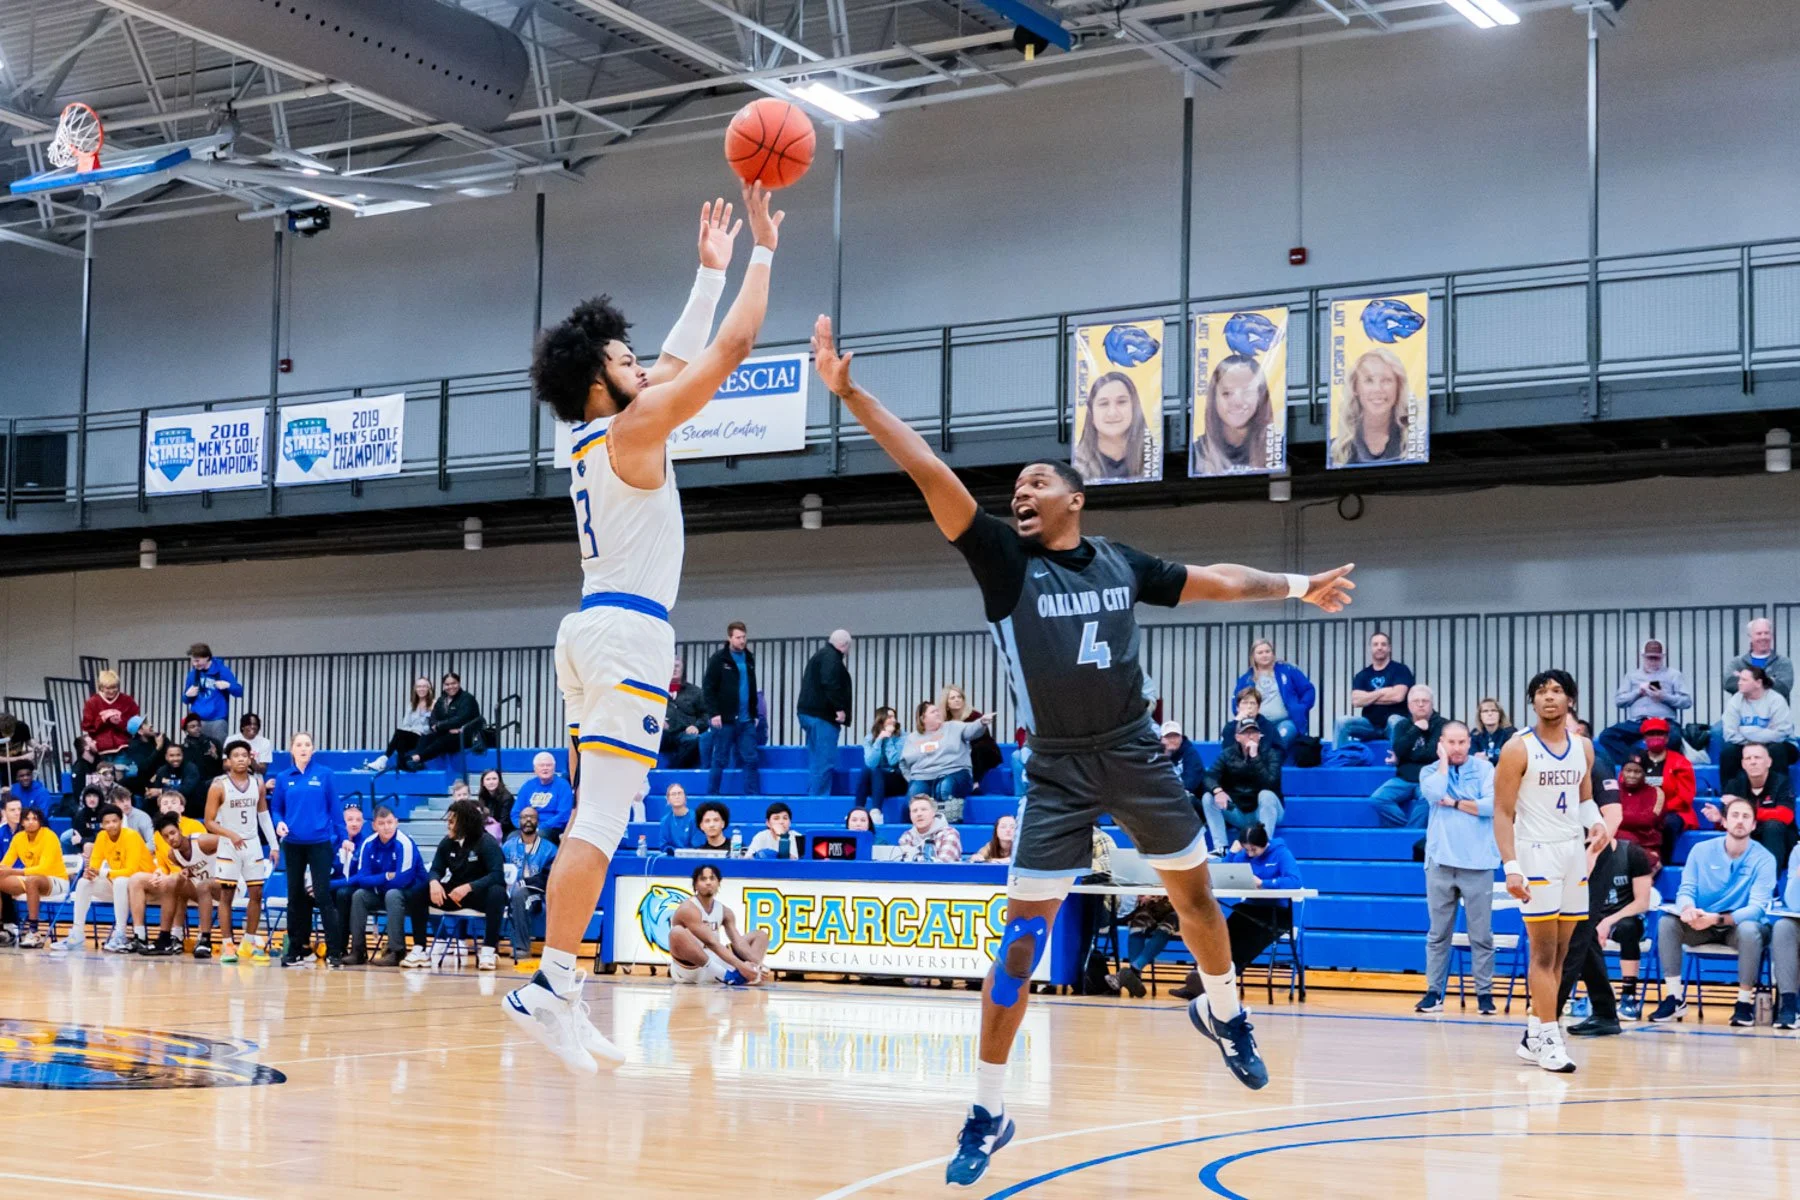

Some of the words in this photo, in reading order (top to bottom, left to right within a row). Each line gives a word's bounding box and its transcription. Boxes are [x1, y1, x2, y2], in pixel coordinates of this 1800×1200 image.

[718, 366, 796, 393] ESCIA!
[353, 409, 379, 429] 2019
[210, 422, 249, 440] 2018
[334, 430, 366, 446] MEN'S
[370, 427, 398, 443] GOLF
[681, 422, 723, 441] Second
[723, 420, 767, 440] Century
[149, 442, 194, 462] STATES
[198, 440, 231, 457] MEN'S
[235, 436, 259, 454] GOLF
[285, 433, 330, 454] STATES
[1143, 427, 1152, 478] HANNAH
[198, 454, 258, 476] CHAMPIONS
[333, 441, 398, 470] CHAMPIONS
[576, 488, 599, 560] 3
[1037, 590, 1101, 618] OAKLAND
[1102, 586, 1131, 612] CITY
[1077, 621, 1112, 669] 4
[1539, 769, 1581, 786] BRESCIA
[1556, 791, 1568, 814] 4
[240, 810, 248, 825] 5
[743, 887, 1009, 960] BEARCATS
[788, 950, 860, 965] BRESCIA
[869, 952, 981, 970] UNIVERSITY
